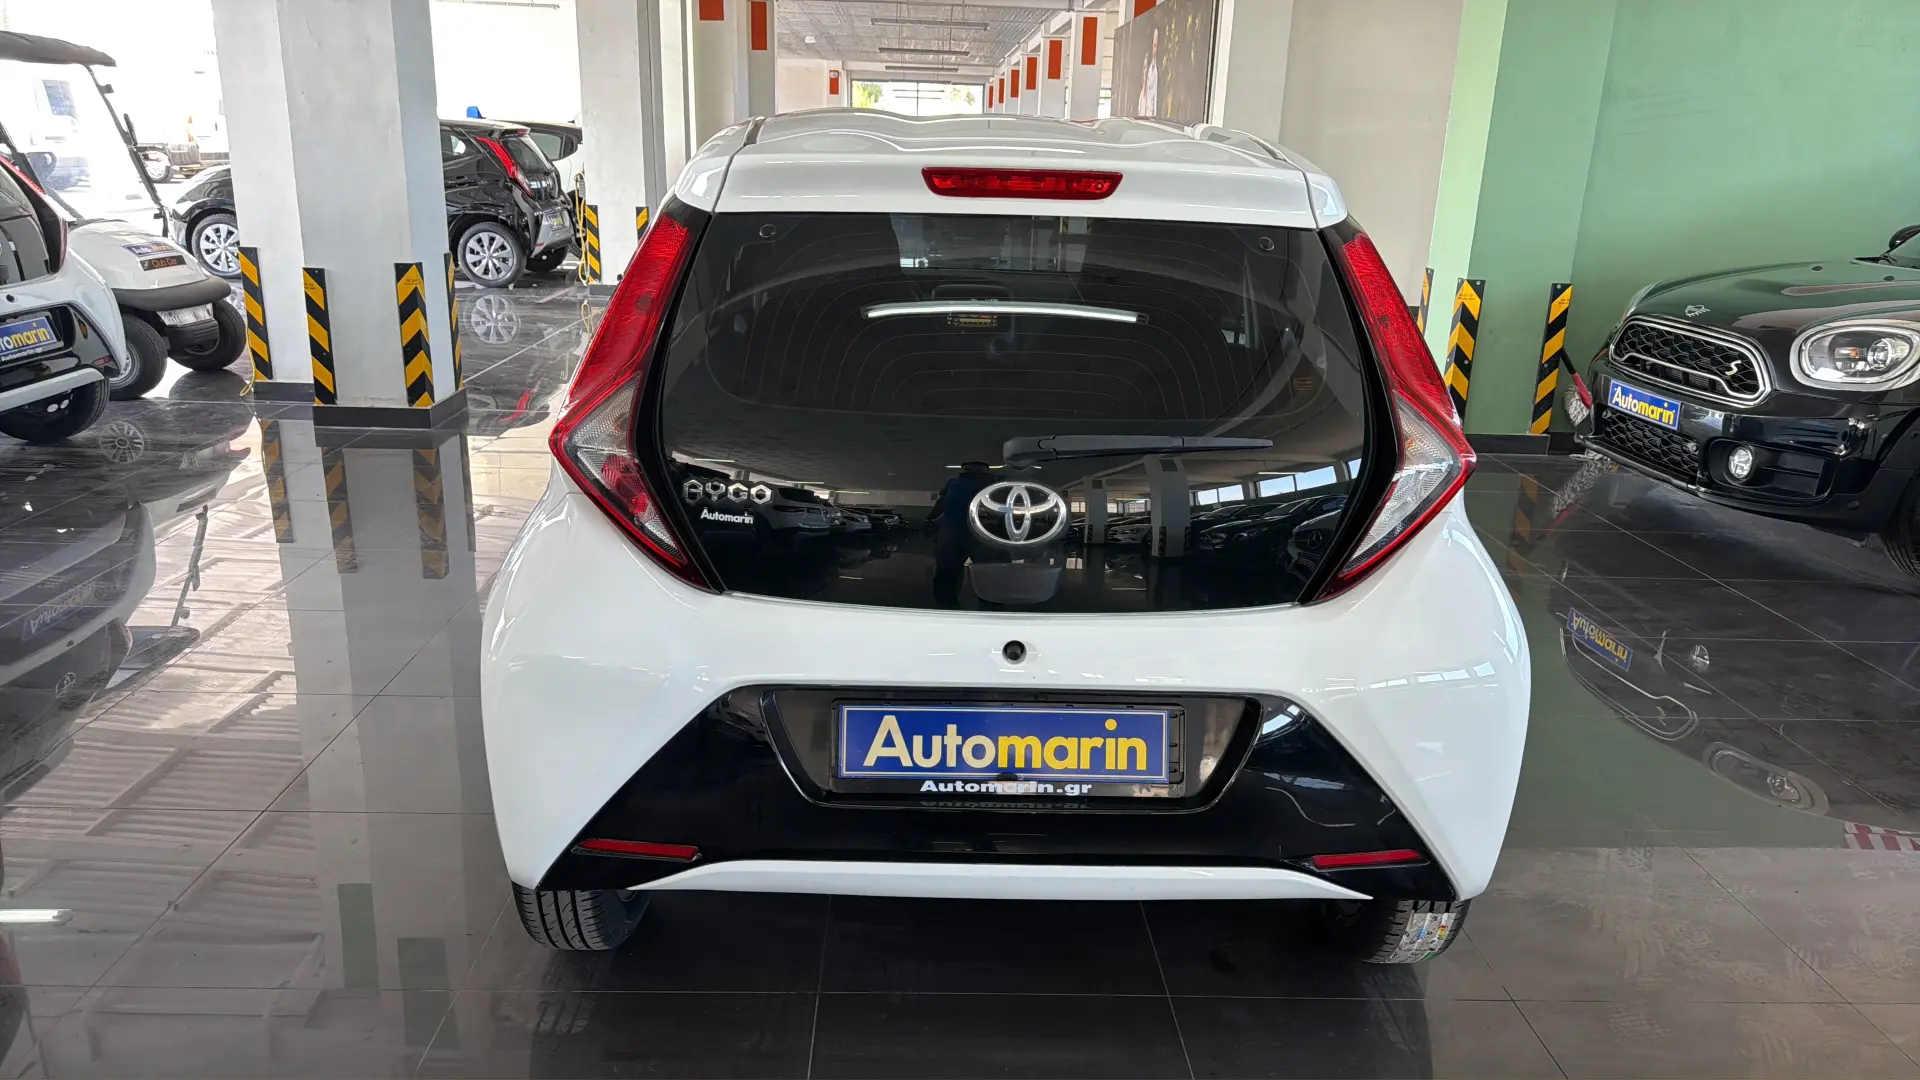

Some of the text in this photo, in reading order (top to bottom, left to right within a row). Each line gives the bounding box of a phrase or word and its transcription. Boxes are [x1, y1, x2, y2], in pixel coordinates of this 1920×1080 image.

[151, 257, 177, 268] Club Car
[1612, 386, 1675, 424] Automarin
[683, 479, 772, 505] AYGO
[700, 508, 754, 524] Automarin
[863, 714, 1147, 771] Automarin
[920, 780, 1092, 796] Automarin.gr
